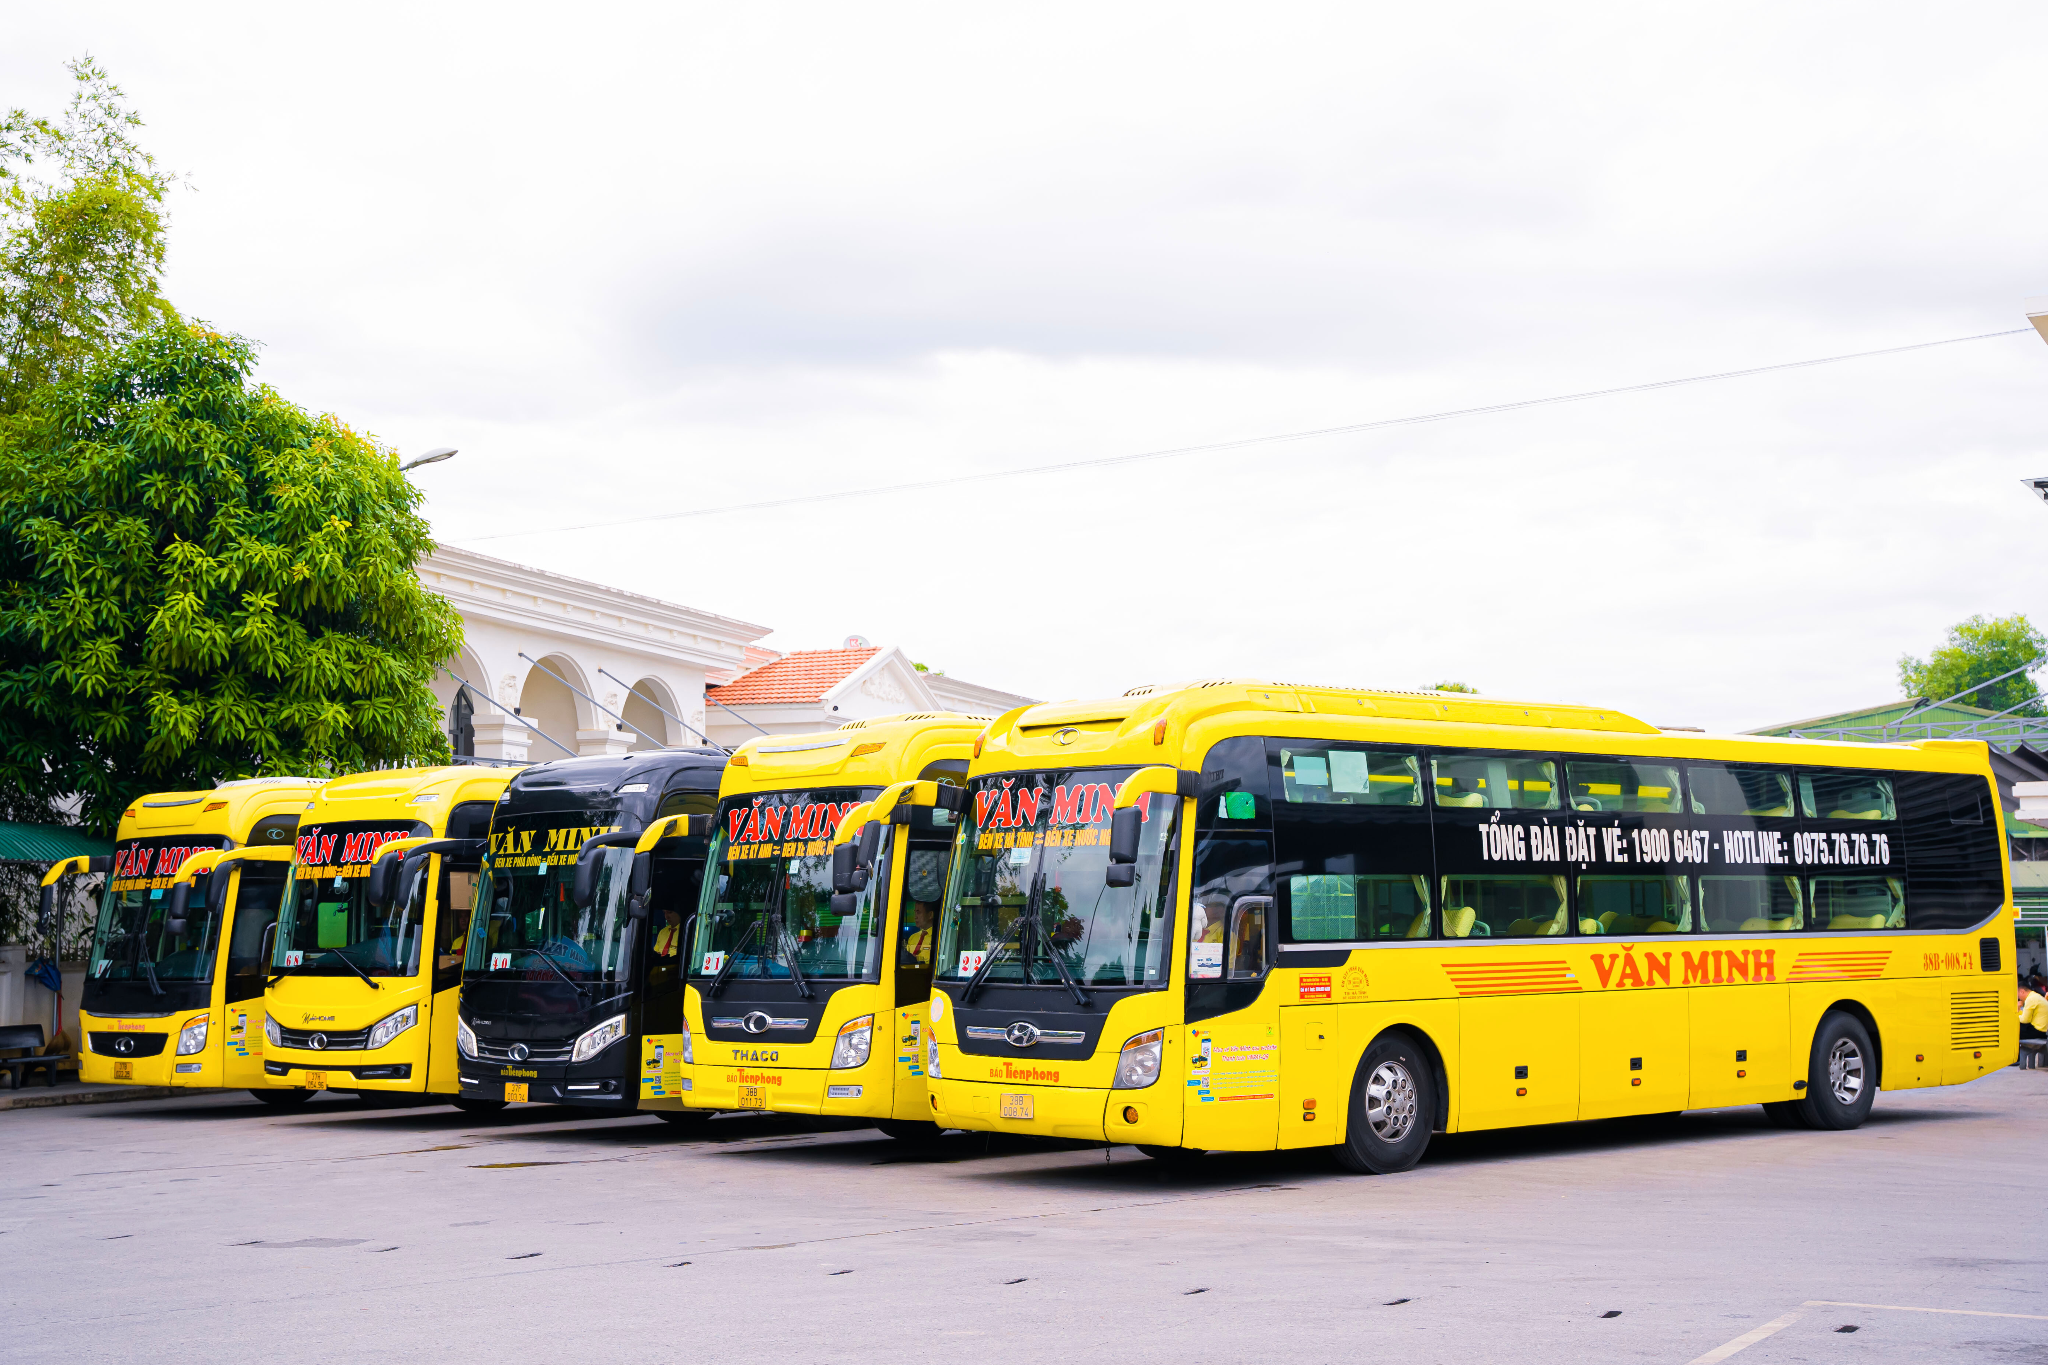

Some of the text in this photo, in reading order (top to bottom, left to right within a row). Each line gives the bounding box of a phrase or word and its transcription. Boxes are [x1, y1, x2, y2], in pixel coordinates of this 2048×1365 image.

[976, 778, 1043, 828] VĂN
[729, 798, 872, 842] VĂN MIN
[296, 826, 338, 865] VĂN
[490, 826, 536, 856] VĂN
[978, 828, 993, 849] BẾN
[993, 833, 1004, 848] XE
[1004, 829, 1015, 848] HÀ
[1044, 824, 1062, 847] BẾN
[1062, 830, 1074, 846] XE
[1074, 824, 1098, 846] NƯỚC
[1479, 810, 1526, 860] TỔNG
[1530, 818, 1560, 862] ĐÀI
[1565, 820, 1596, 870] ĐẶT
[1602, 820, 1628, 862] VÉ:
[1631, 828, 1670, 863] 1900
[1673, 829, 1709, 863] 6467
[1723, 830, 1788, 864] HOTLINE:
[1793, 832, 1890, 865] 0975.76.76.76
[114, 842, 154, 876] VĂN
[727, 840, 740, 860] BẾN
[740, 845, 749, 859] XE
[704, 956, 720, 971] 21
[962, 955, 982, 972] 22
[1590, 944, 1776, 989] VĂN MINH
[1924, 952, 1973, 971] 38B-008.74
[732, 1050, 779, 1062] THACO
[990, 1066, 1003, 1078] BÁO
[1004, 1106, 1029, 1117] 008.74
